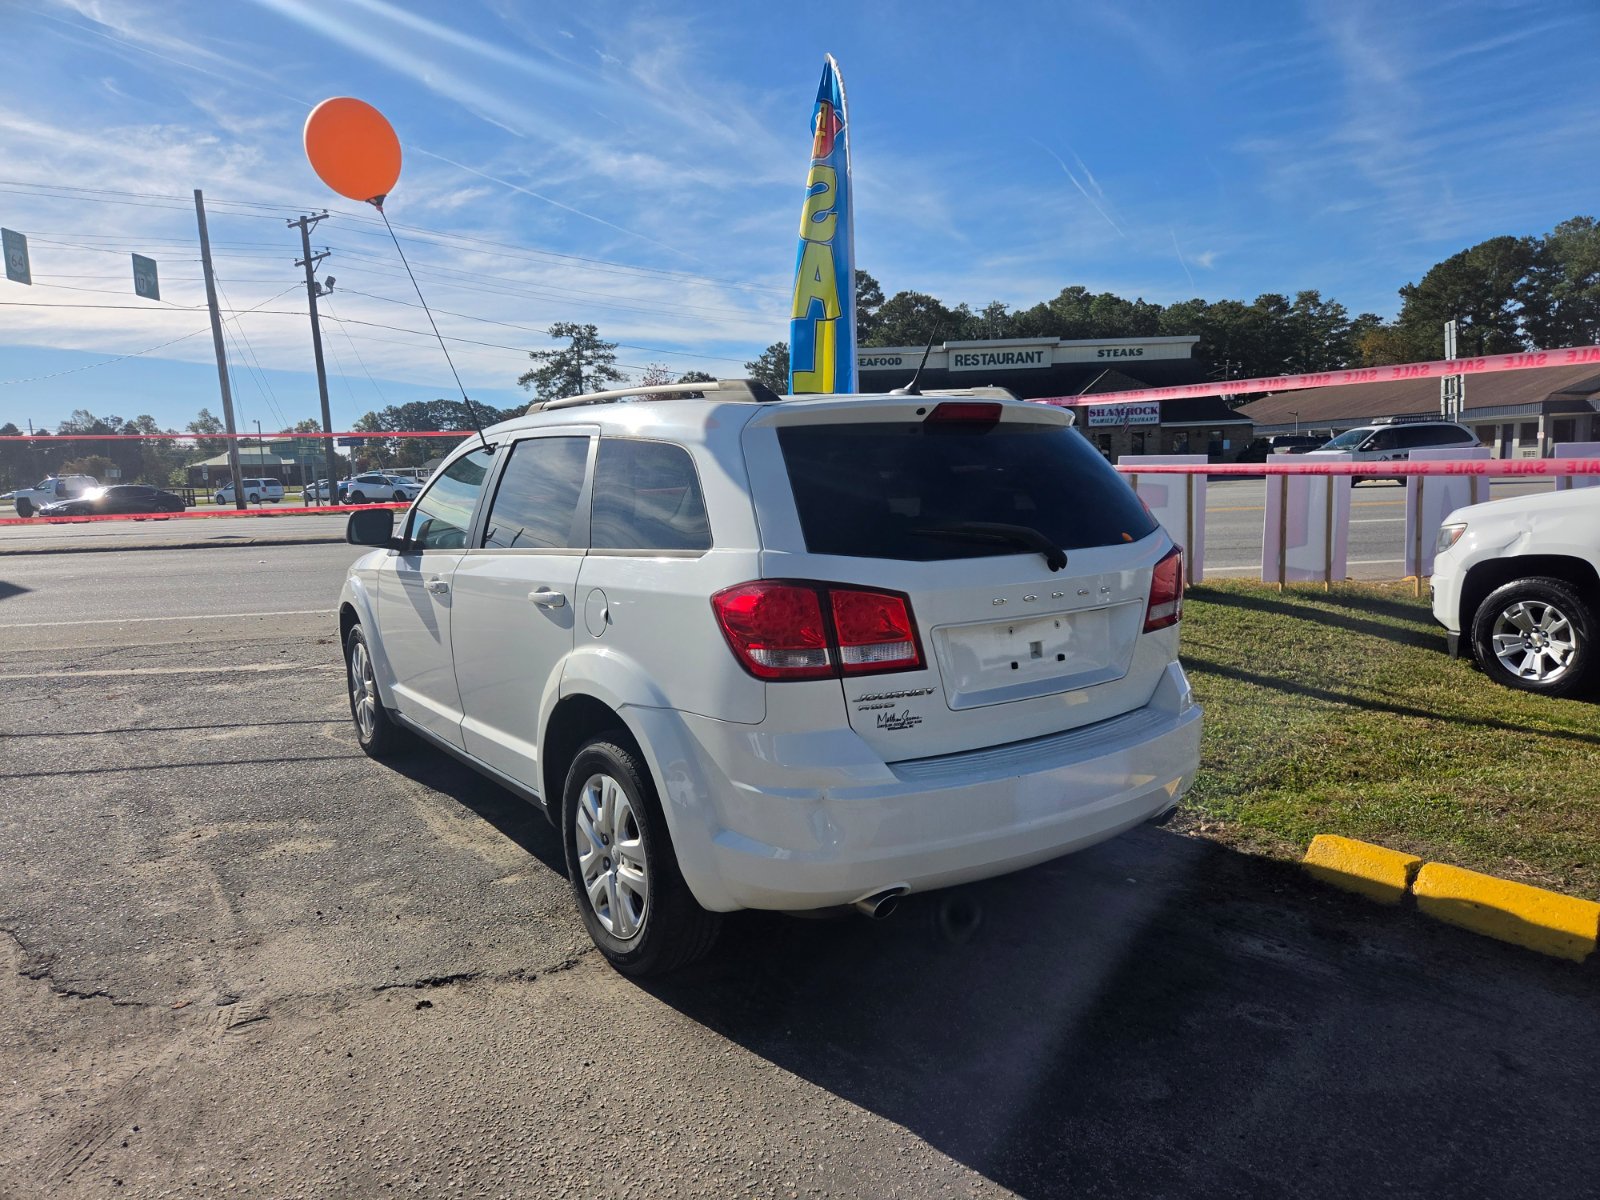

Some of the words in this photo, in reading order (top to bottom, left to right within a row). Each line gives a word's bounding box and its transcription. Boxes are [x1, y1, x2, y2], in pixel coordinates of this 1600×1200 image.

[11, 255, 24, 268] 64
[954, 350, 1044, 367] RESTAURANT
[1097, 347, 1144, 358] STEAKS
[1089, 406, 1158, 417] SHAMROCK
[992, 585, 1111, 606] DODGE
[852, 686, 937, 702] JOURNEY
